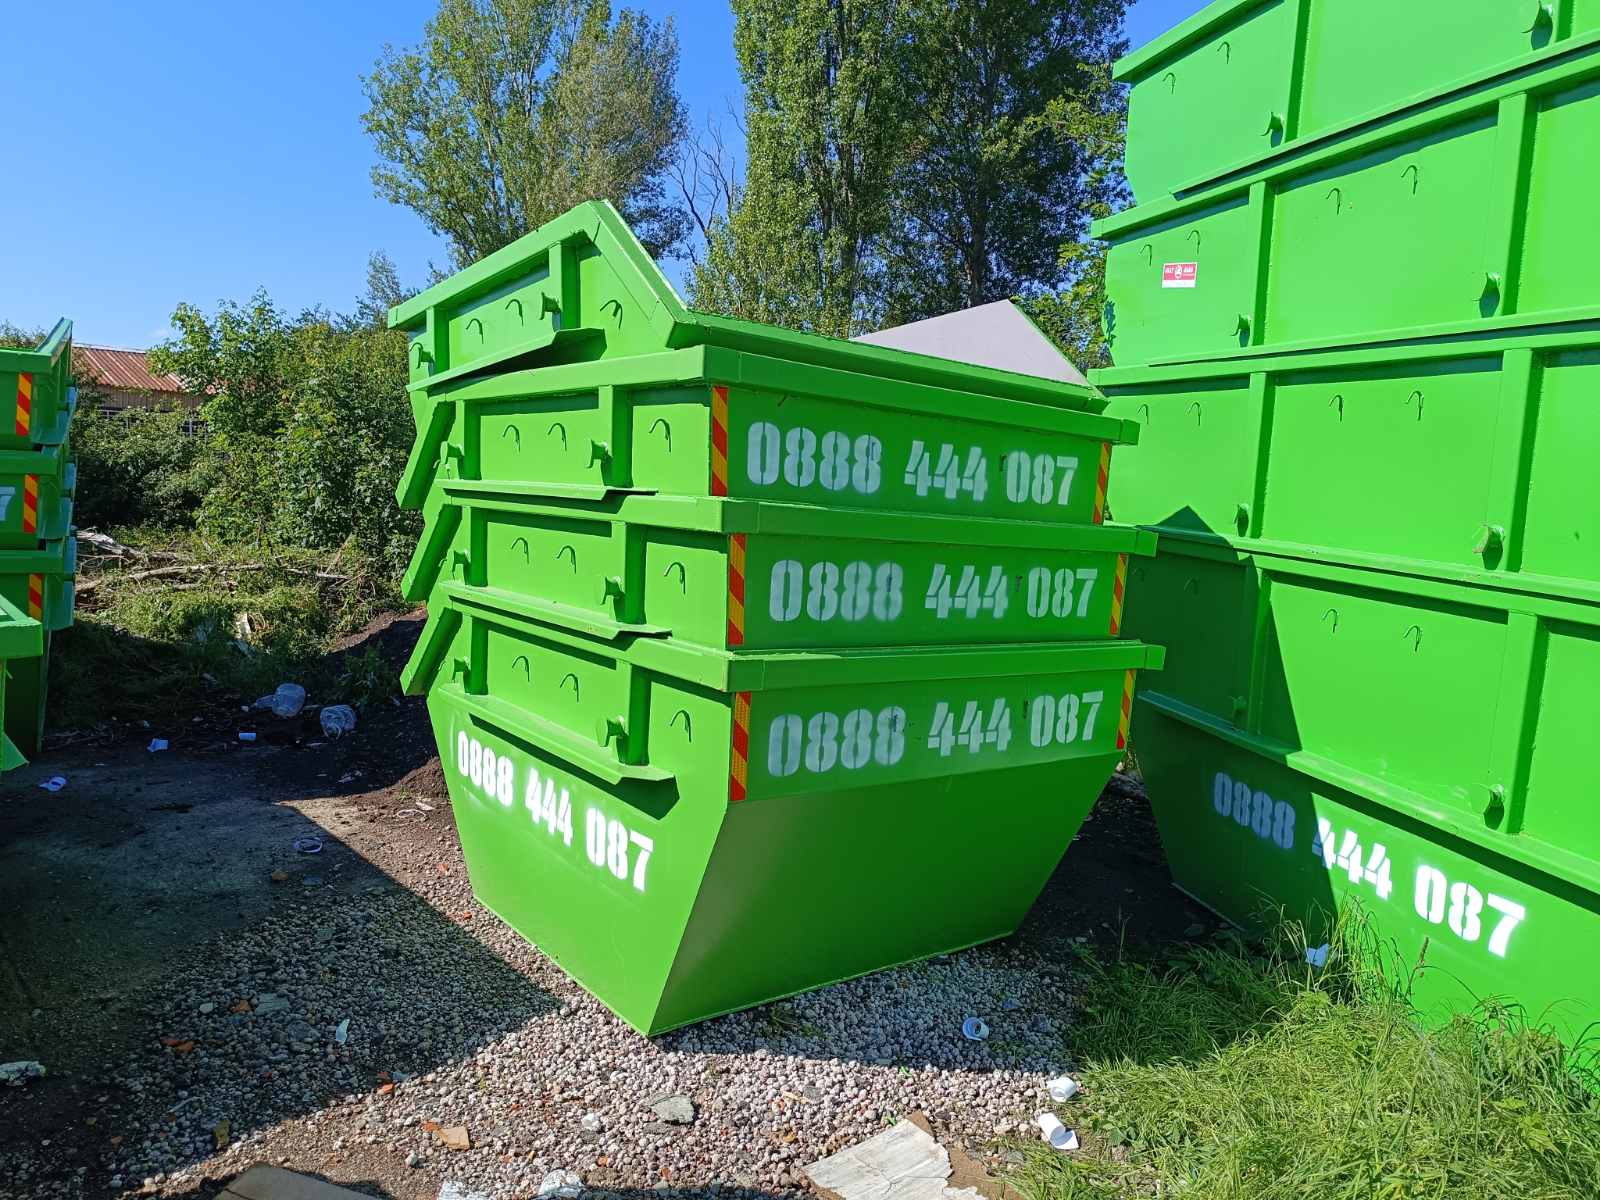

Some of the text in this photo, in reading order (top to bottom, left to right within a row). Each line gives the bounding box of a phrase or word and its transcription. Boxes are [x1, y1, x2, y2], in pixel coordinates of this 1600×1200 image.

[747, 422, 1078, 506] 0888 444 087
[769, 559, 1098, 622] 0888 444 087
[767, 690, 1104, 777] 0888 444 087
[457, 730, 654, 893] 0888 444 087
[1213, 772, 1527, 959] 0888 444 087
